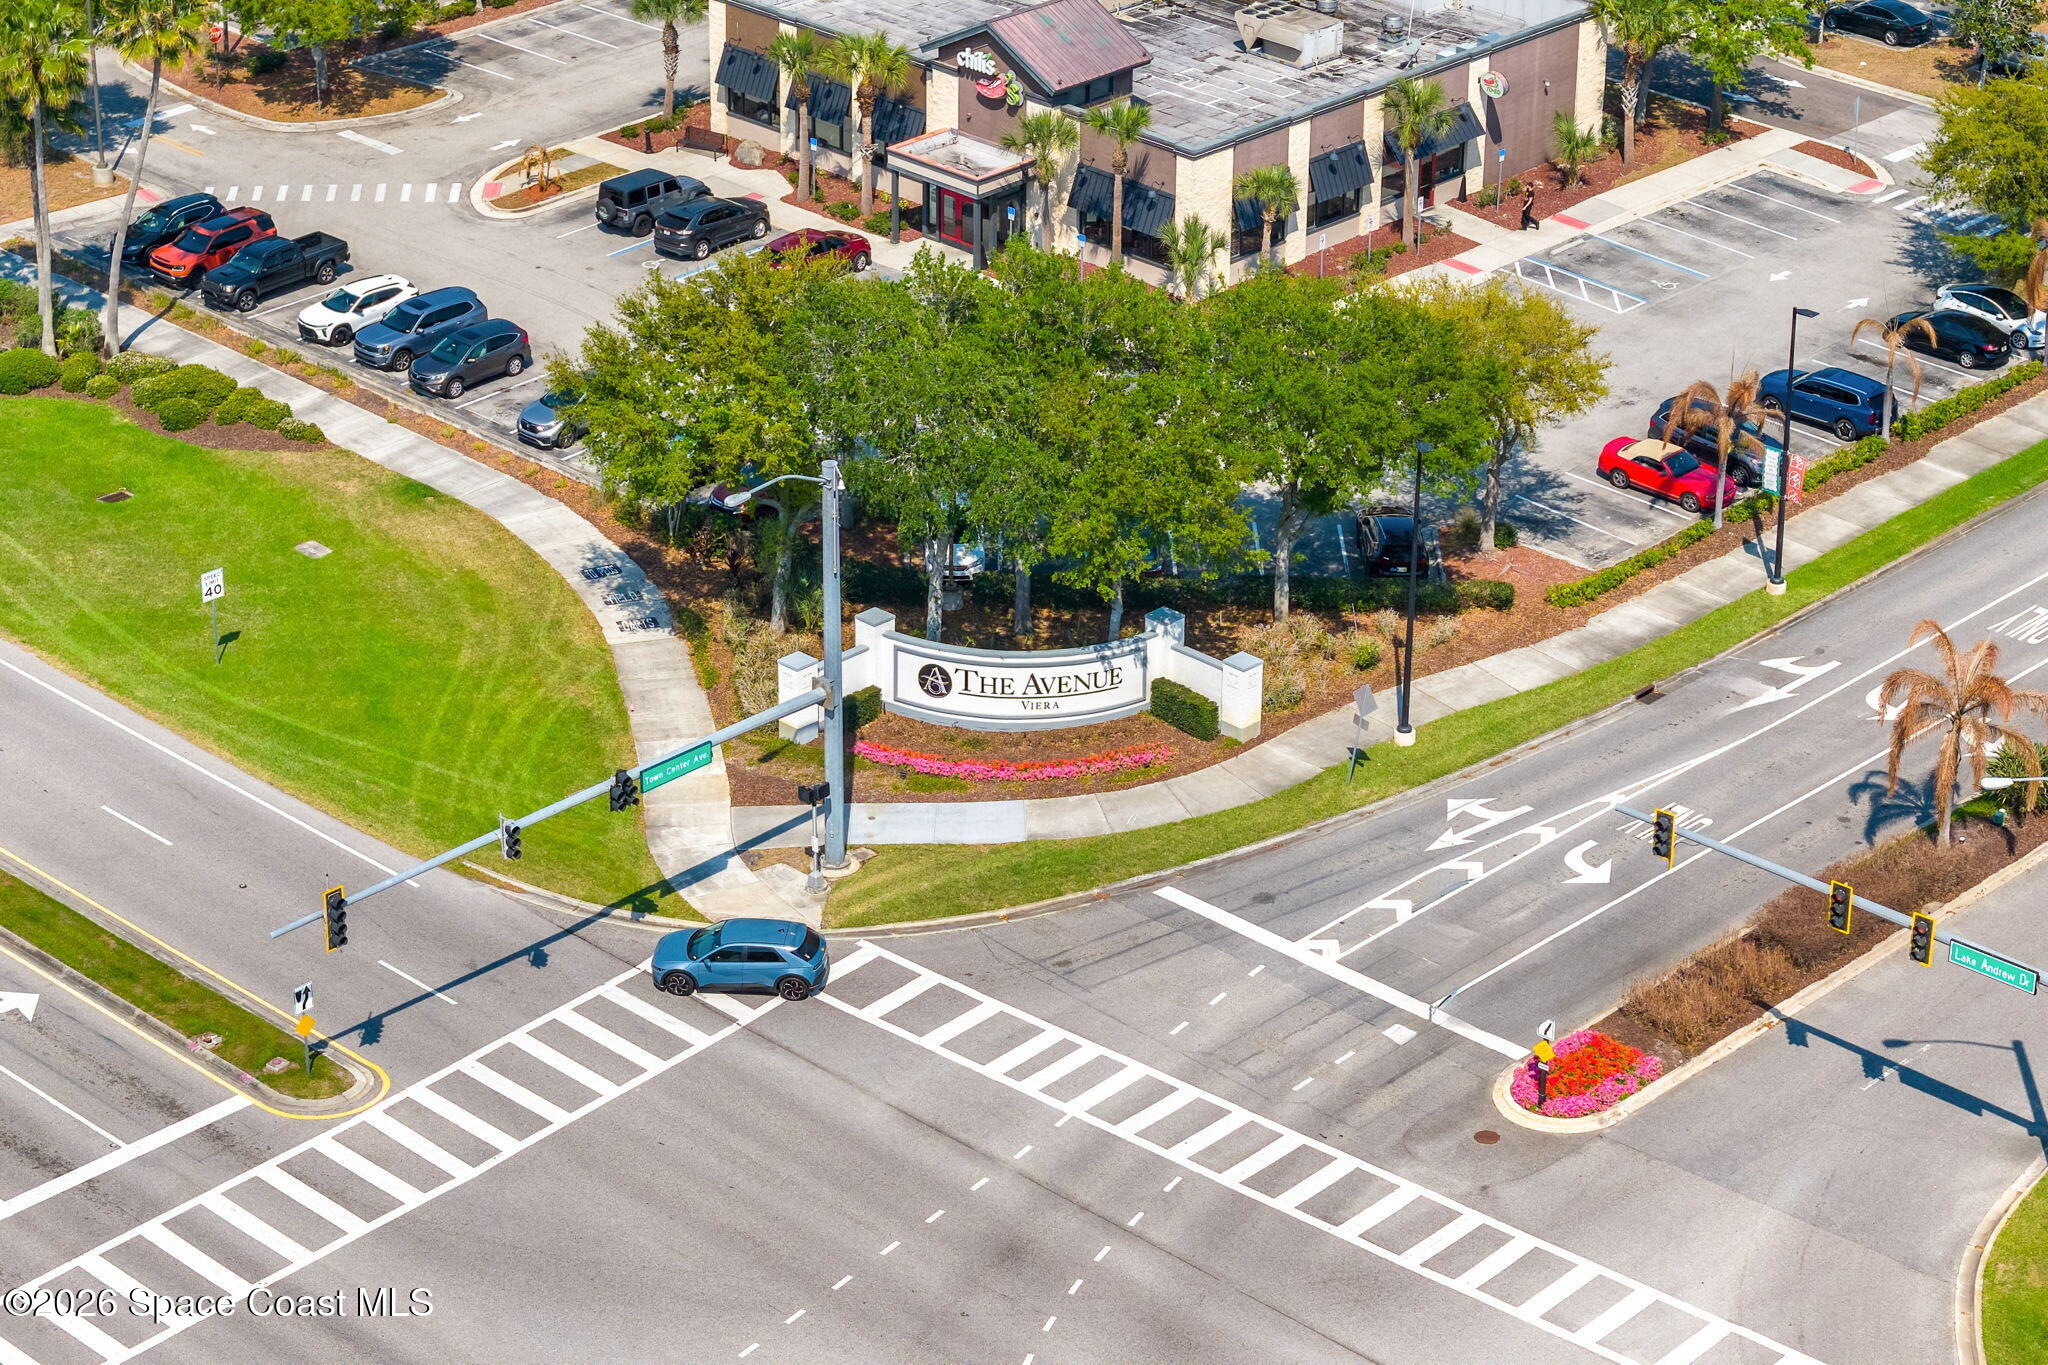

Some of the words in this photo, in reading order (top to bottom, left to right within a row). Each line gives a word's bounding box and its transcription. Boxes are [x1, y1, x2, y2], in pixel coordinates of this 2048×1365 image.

[204, 583, 222, 597] 40
[607, 591, 639, 605] YIELD
[954, 667, 1015, 696] THE
[1021, 666, 1124, 696] AVENUE
[1021, 700, 1060, 711] VIERA
[644, 772, 664, 785] Town
[666, 759, 691, 775] Center
[1954, 946, 1977, 967] Lake
[1980, 958, 2016, 982] Andrew
[2019, 972, 2031, 987] Dr
